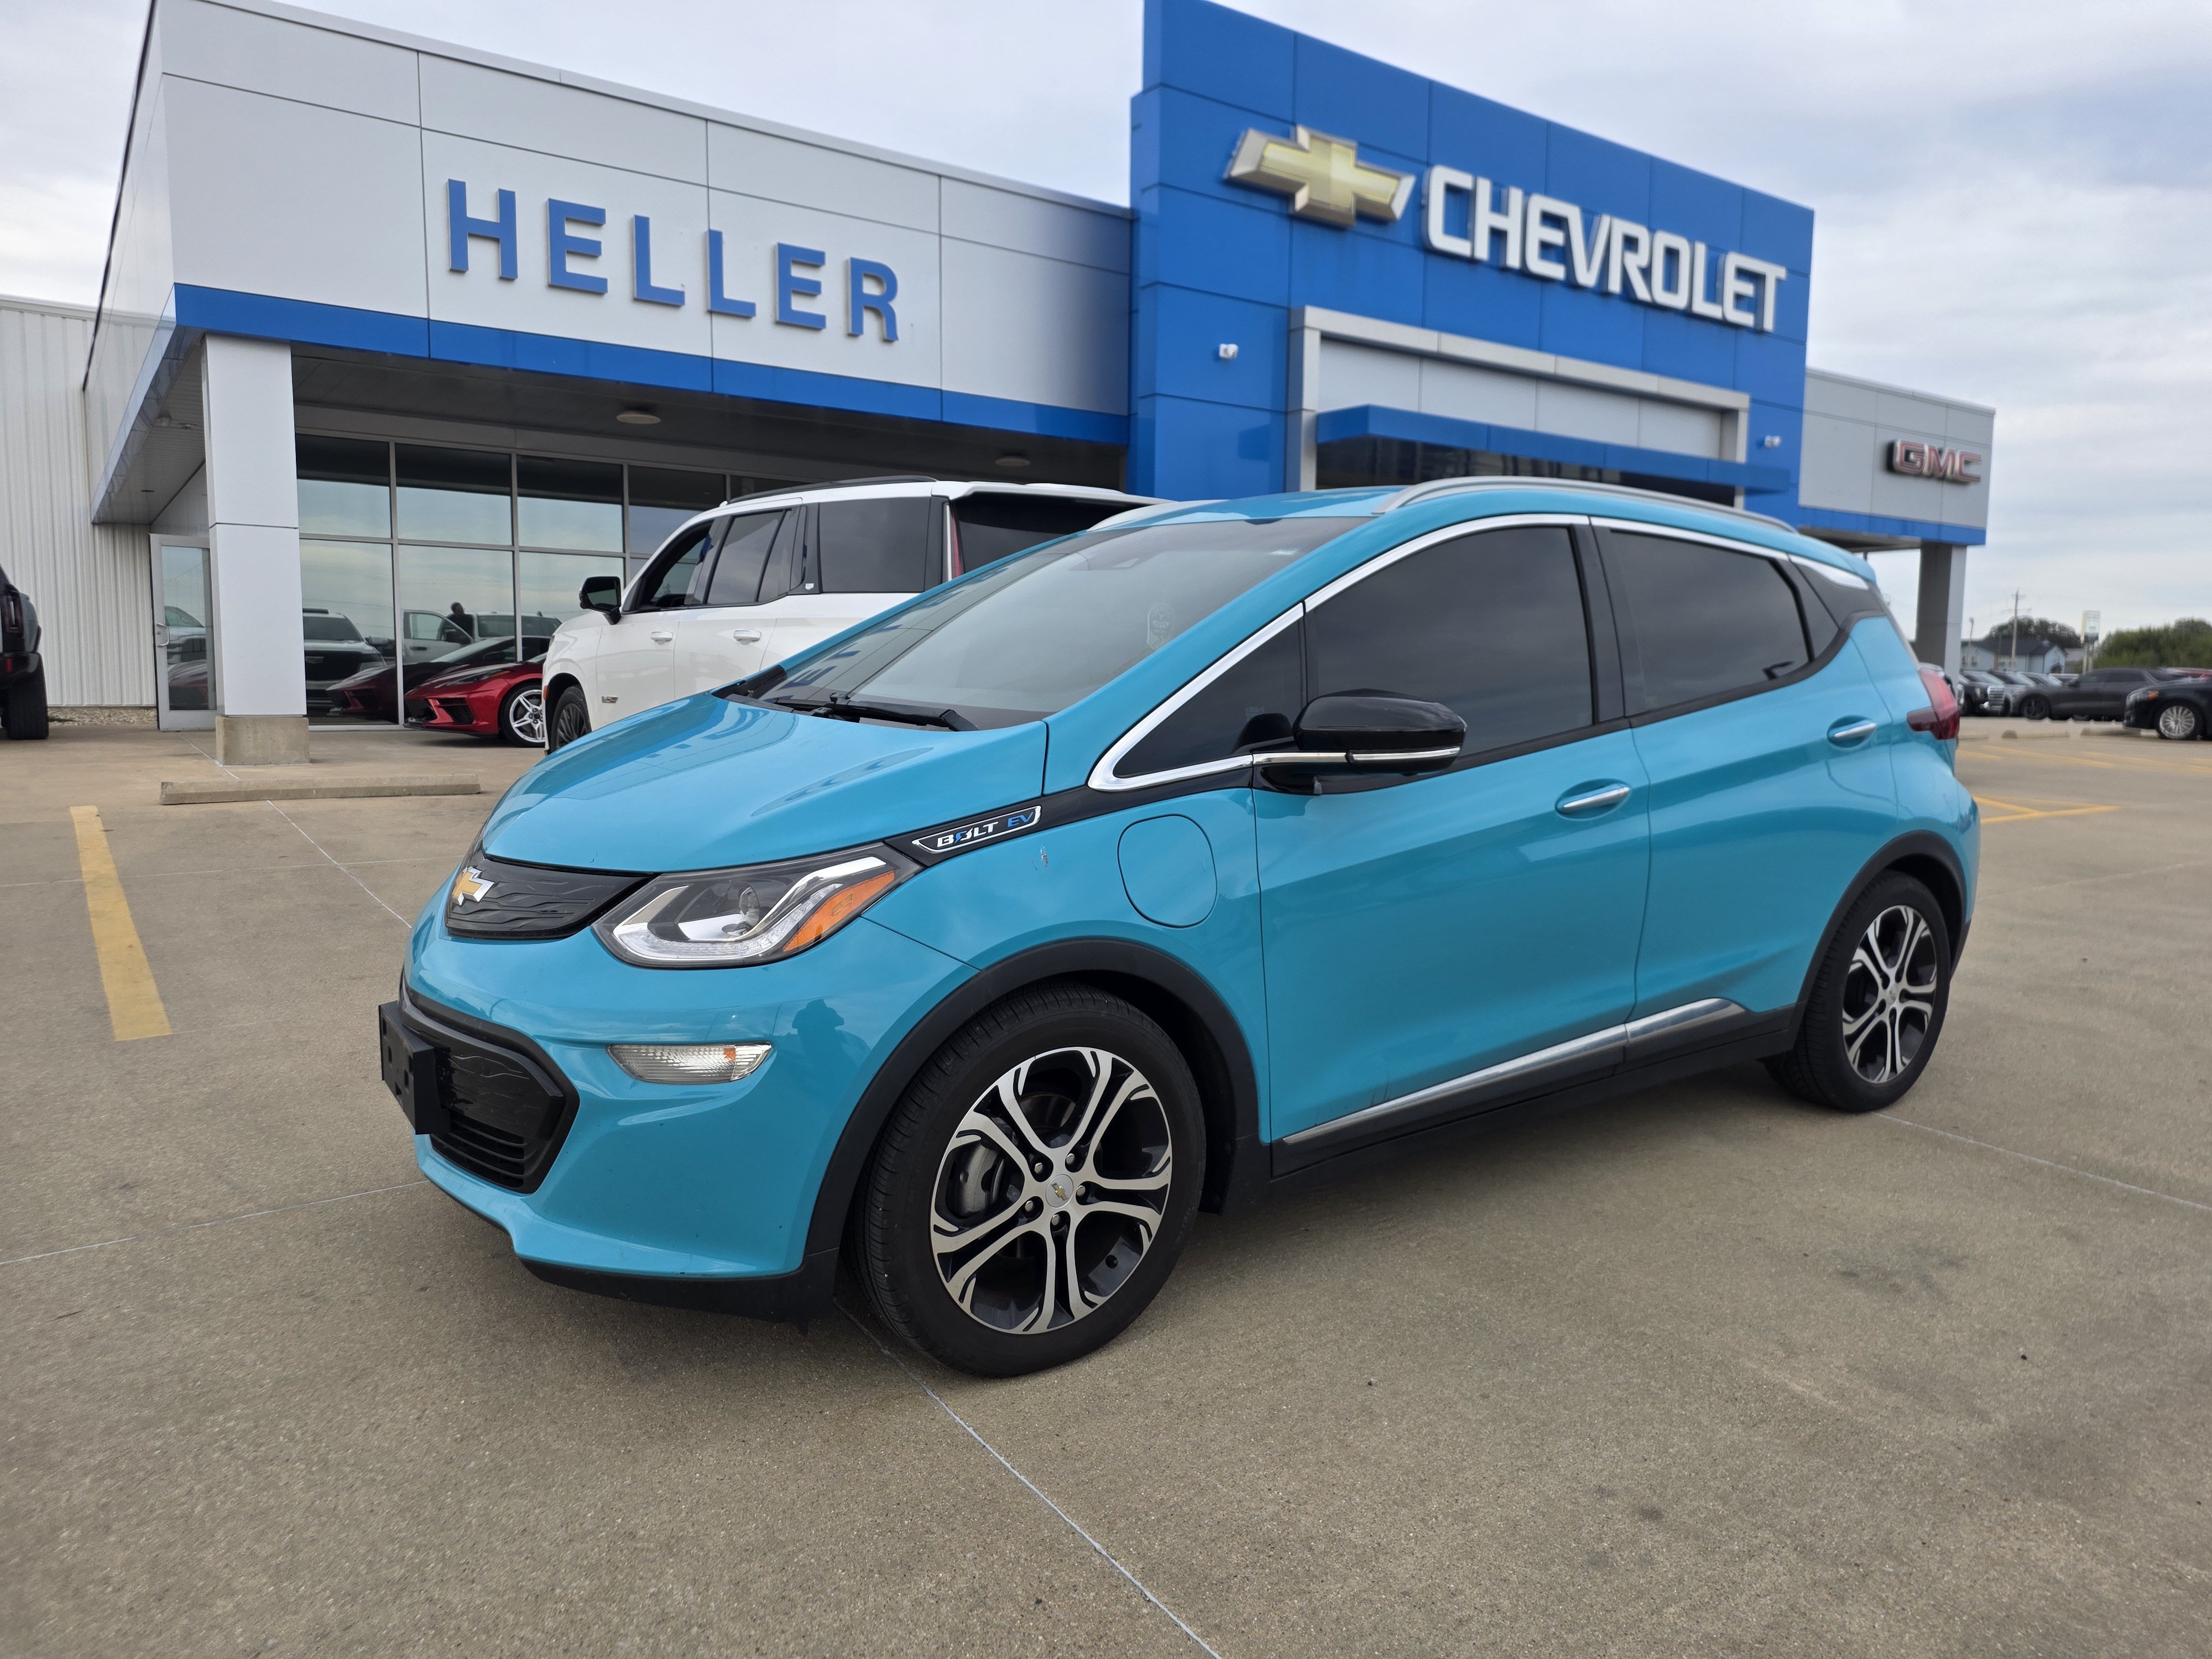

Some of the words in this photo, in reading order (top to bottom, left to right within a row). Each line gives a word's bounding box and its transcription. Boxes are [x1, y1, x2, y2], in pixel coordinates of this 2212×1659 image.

[447, 179, 898, 341] HELLER
[1423, 165, 1786, 332] CHEVROLET
[1893, 440, 1982, 482] GMC
[937, 821, 999, 847] BOLT
[1008, 812, 1034, 828] EV
